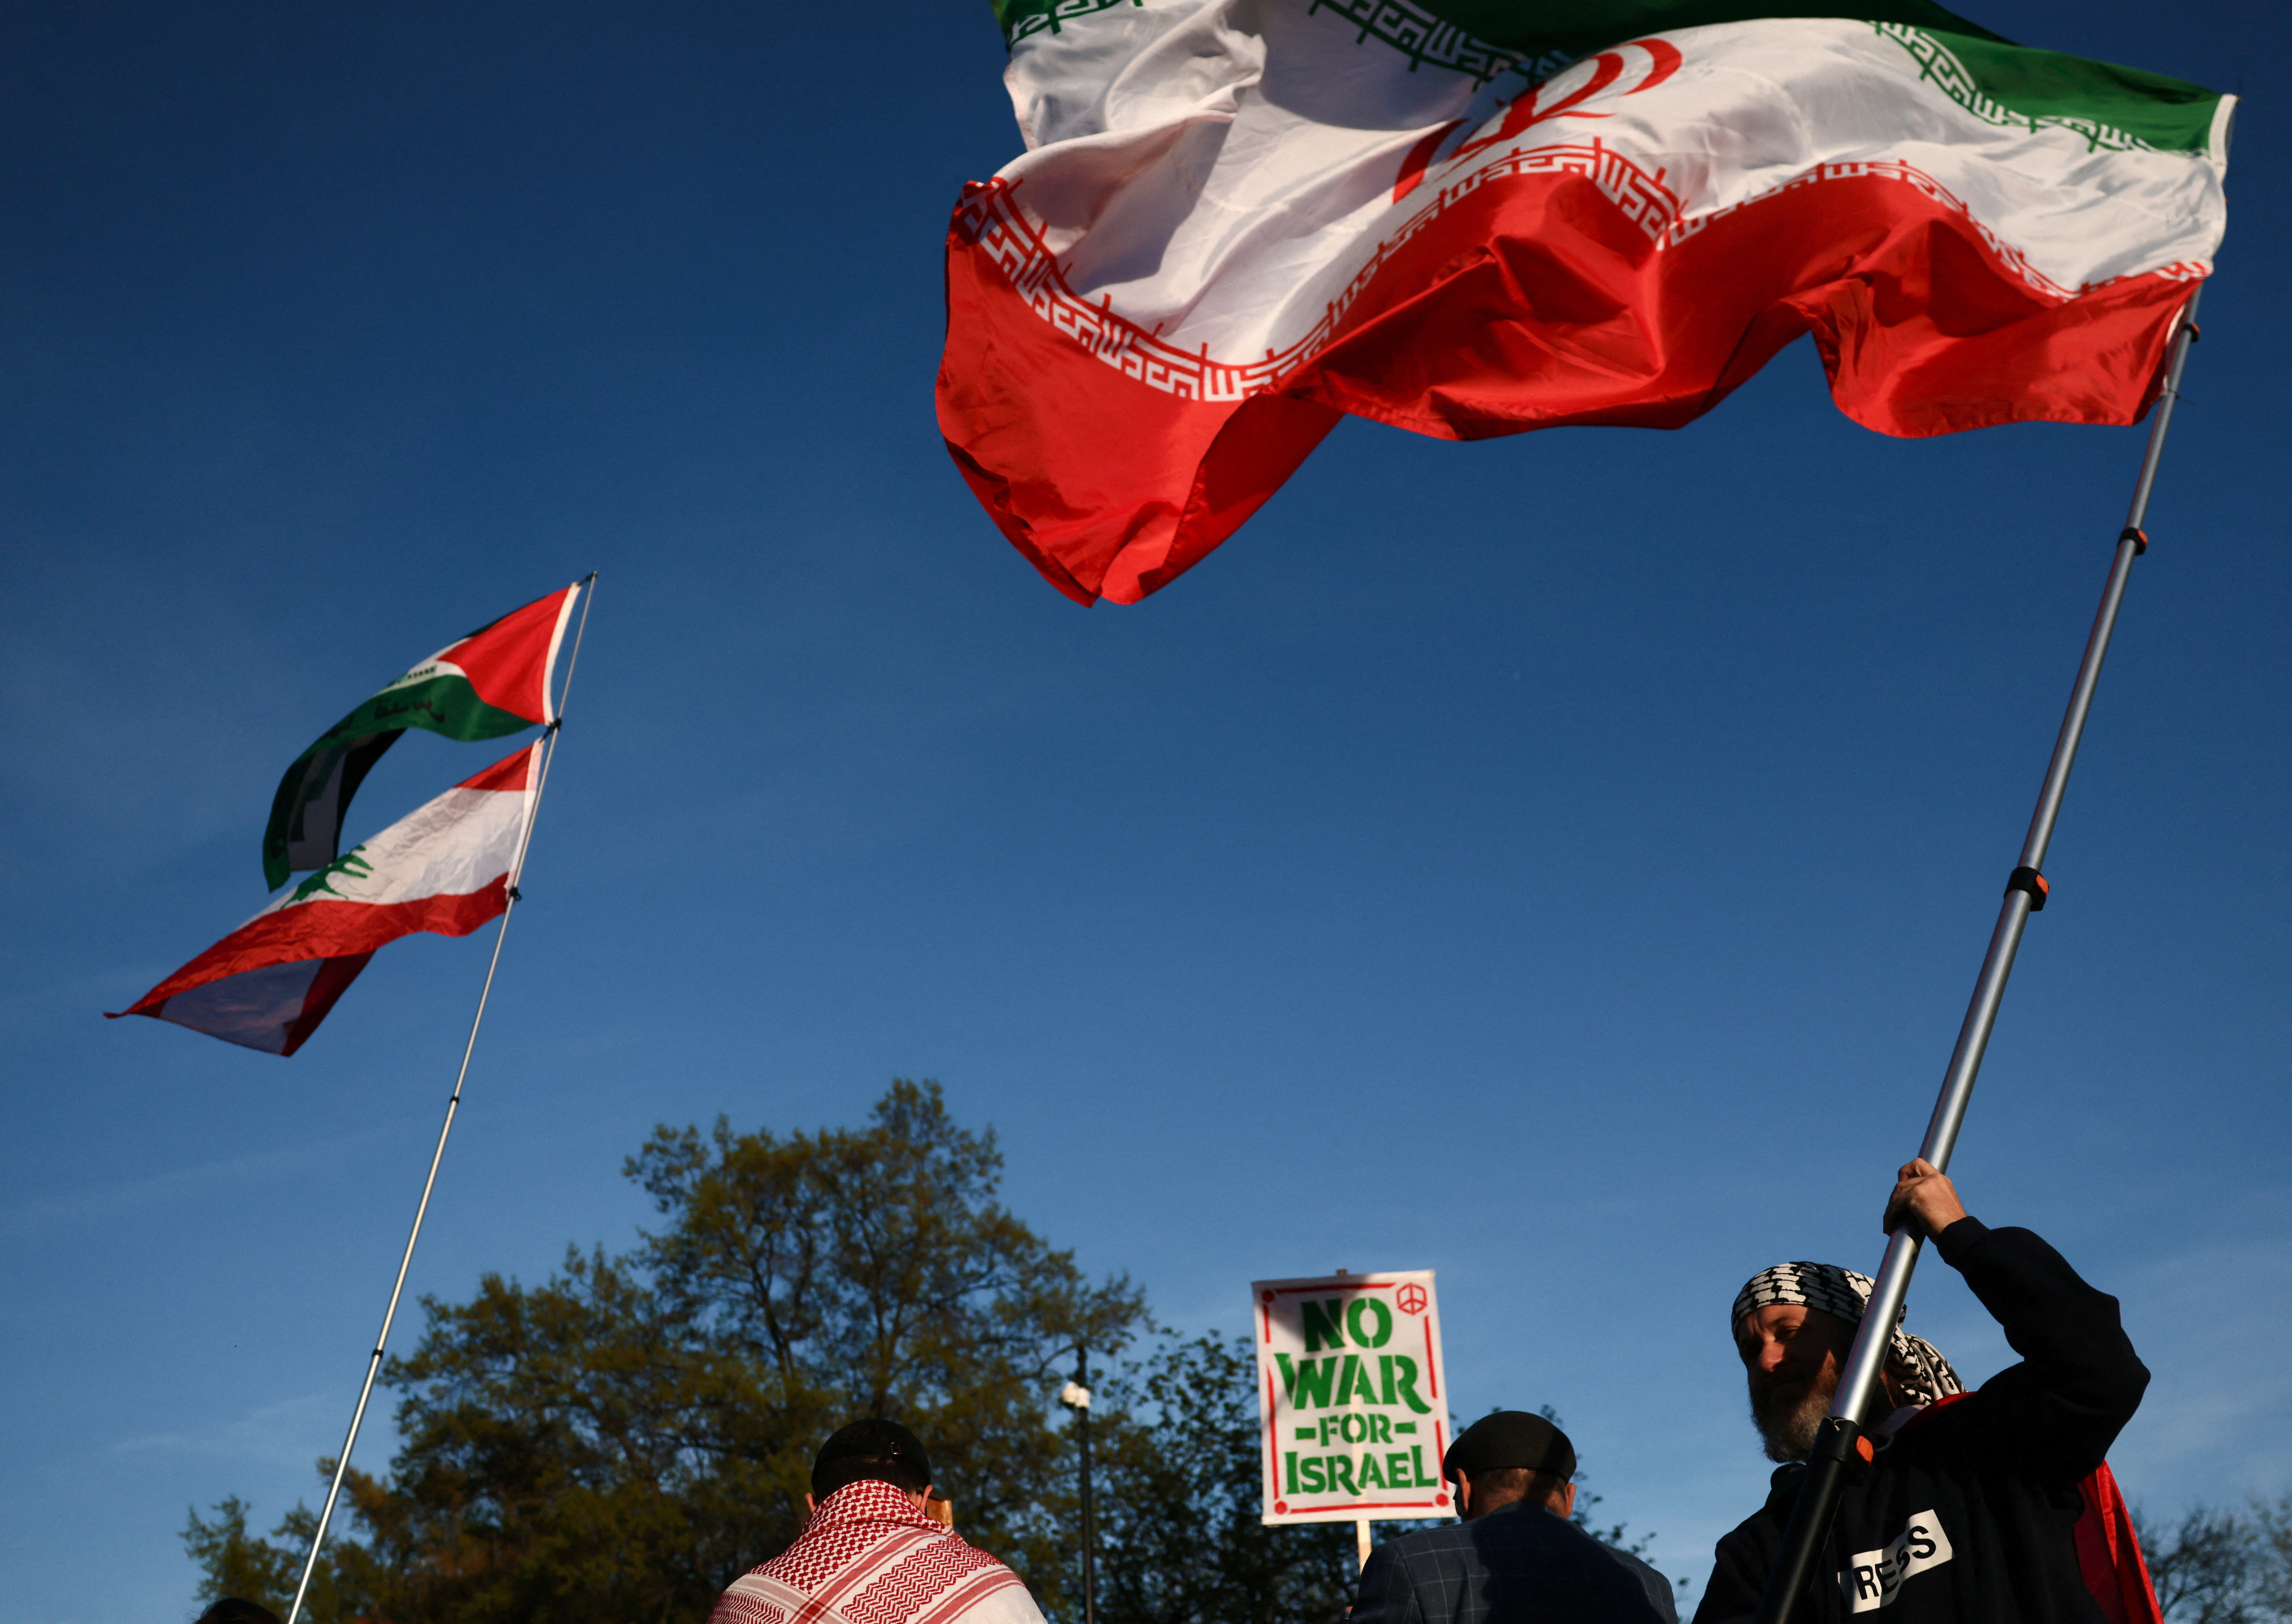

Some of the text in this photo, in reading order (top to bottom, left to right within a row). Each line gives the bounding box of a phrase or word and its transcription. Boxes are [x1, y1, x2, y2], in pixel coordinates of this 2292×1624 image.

[1300, 1297, 1393, 1352] NO
[1274, 1353, 1432, 1414] WAR
[1285, 1445, 1438, 1496] ISRAEL
[1852, 1525, 1936, 1600] RESS
